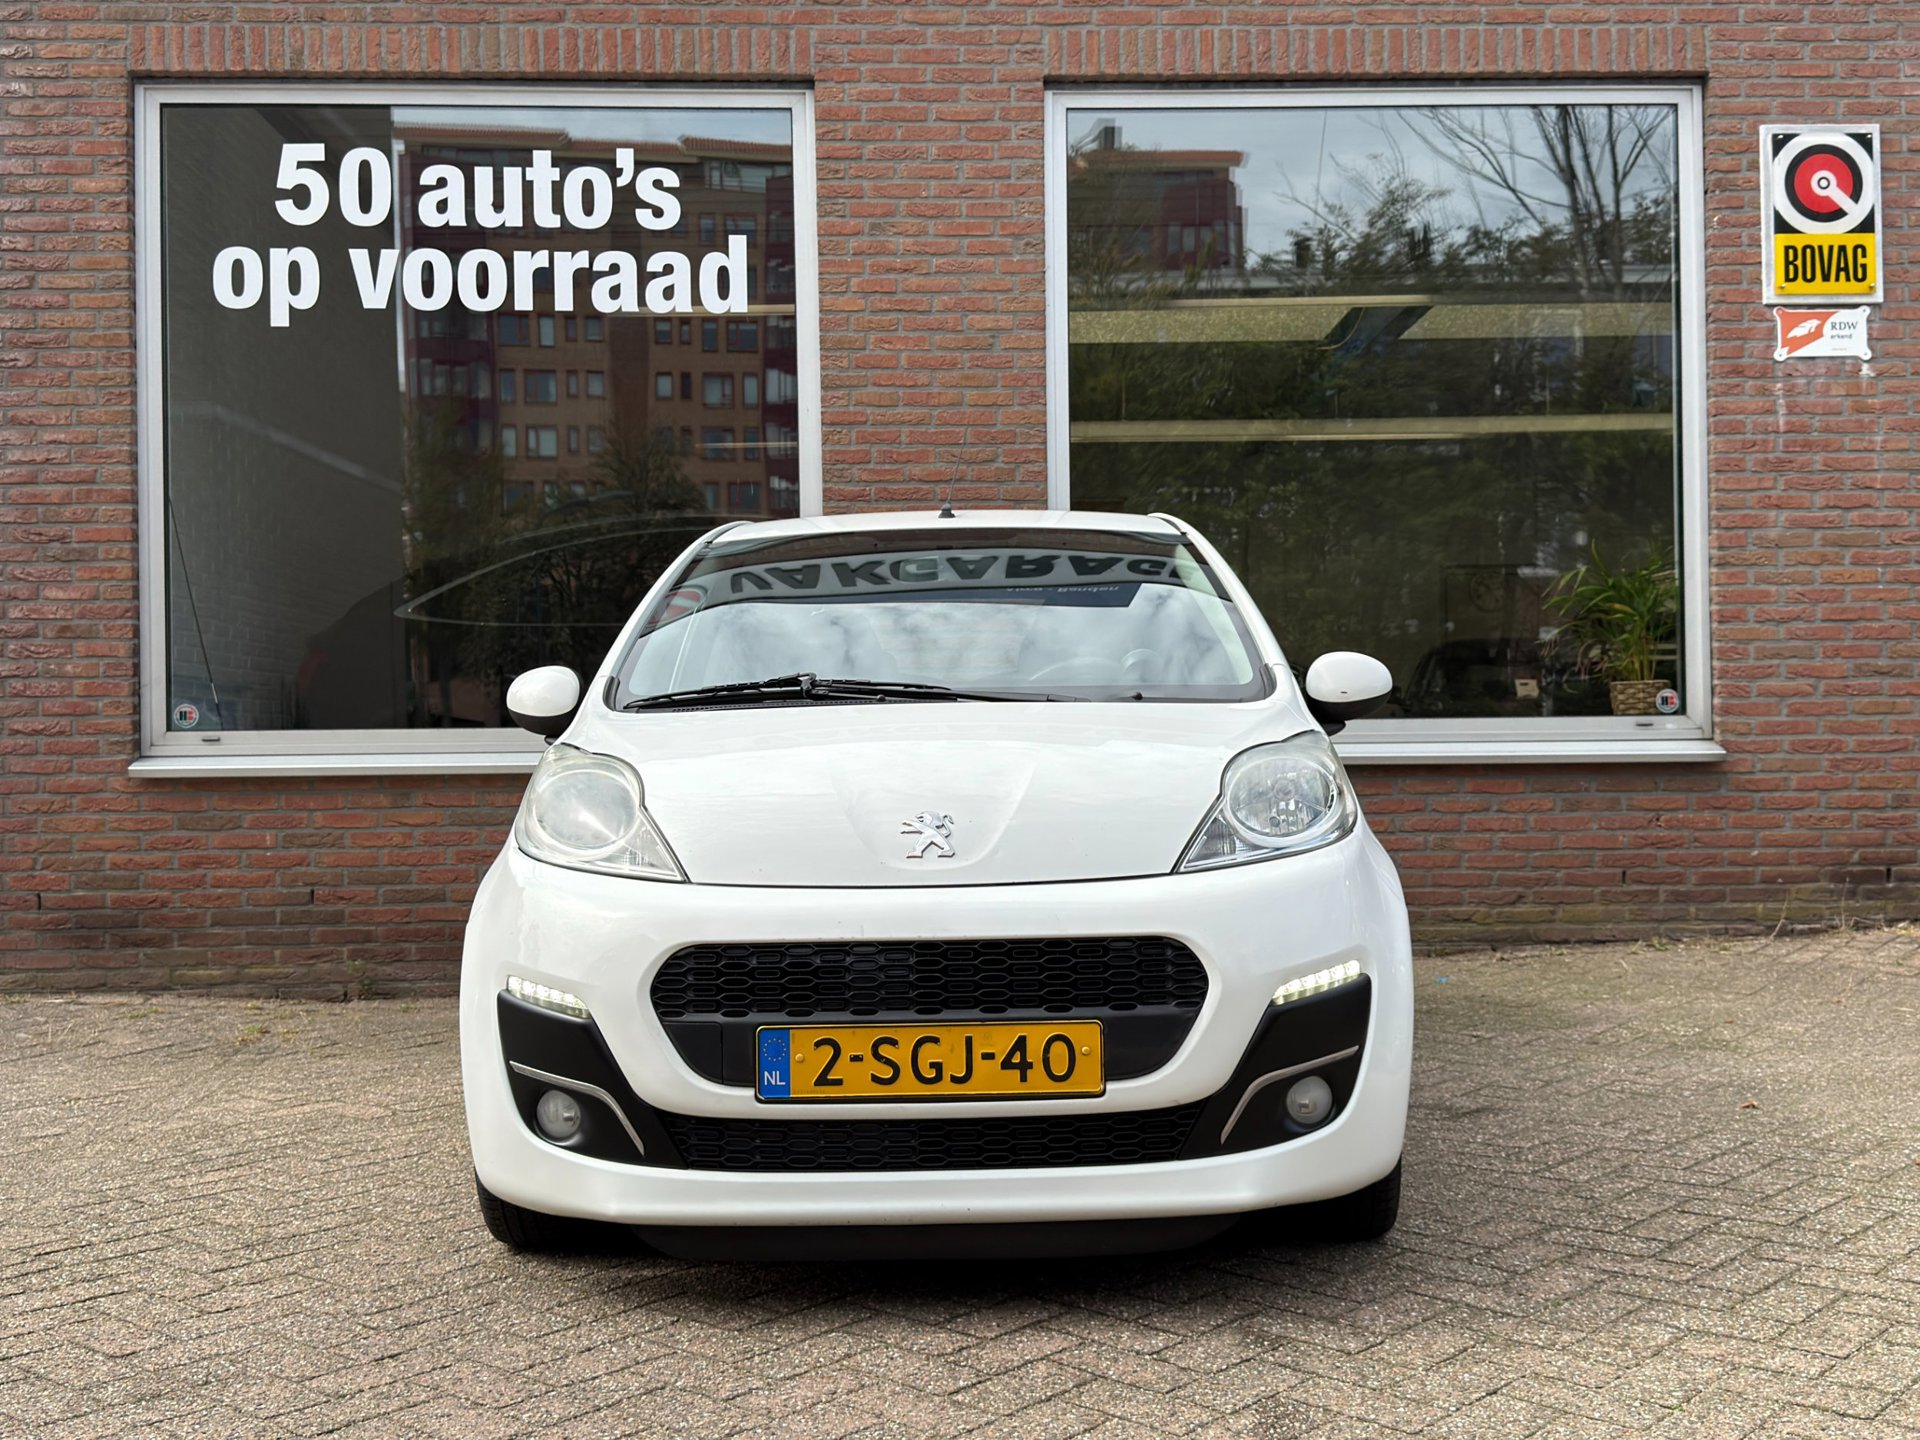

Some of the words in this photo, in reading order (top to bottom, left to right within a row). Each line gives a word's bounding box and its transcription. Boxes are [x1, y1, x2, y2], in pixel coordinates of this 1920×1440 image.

[275, 143, 392, 227] 50
[418, 148, 681, 230] auto's
[212, 246, 320, 327] op
[348, 234, 749, 314] voorraad
[1783, 243, 1868, 284] BOVAG
[1830, 321, 1859, 331] RDW
[764, 1070, 786, 1086] NL
[813, 1033, 1077, 1087] 2-SGJ-40
